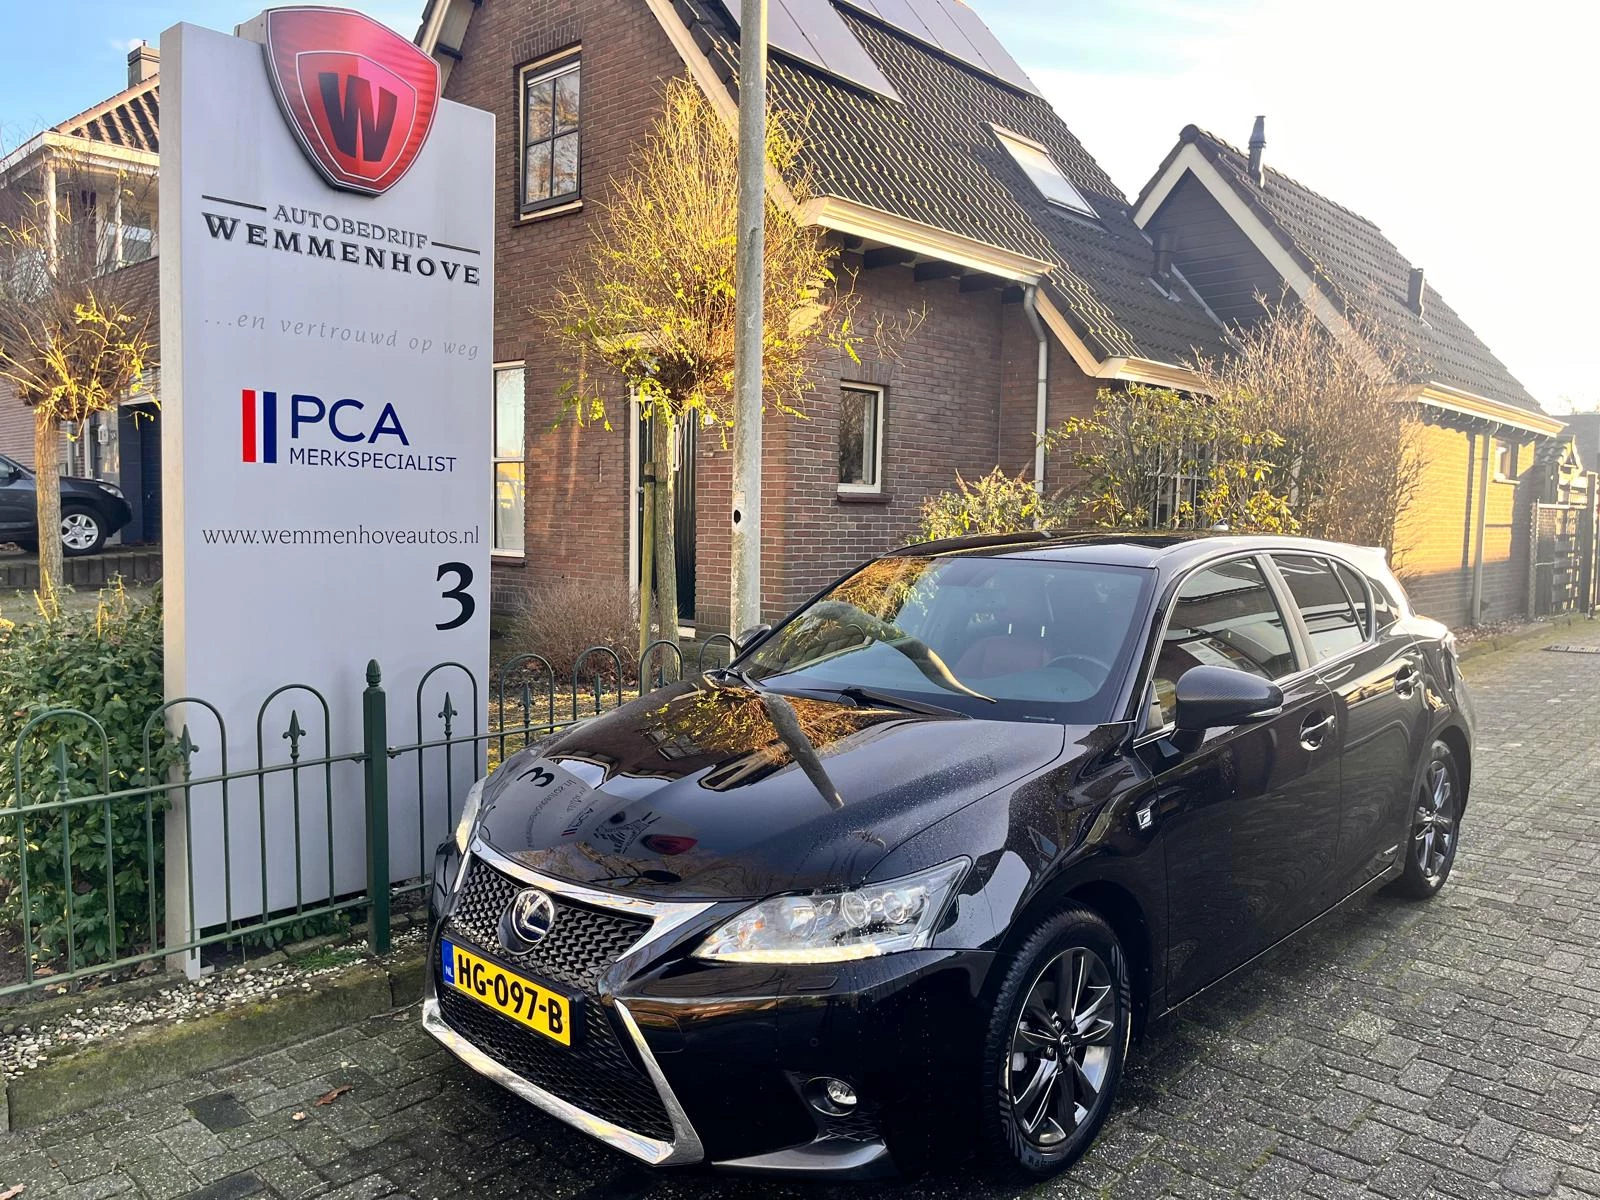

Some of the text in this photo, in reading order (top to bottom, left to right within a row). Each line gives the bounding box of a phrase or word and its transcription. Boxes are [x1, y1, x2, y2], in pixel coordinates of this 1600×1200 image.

[318, 72, 398, 162] W
[201, 212, 480, 285] WEMMENHOVE
[273, 204, 428, 249] AUTOBEDRIJF
[204, 313, 478, 360] ...en vertrouwd op weg
[291, 394, 409, 446] PCA
[289, 447, 457, 472] MERKSPECIALIST
[202, 525, 479, 545] www.wemmenhoveautos.nl
[435, 561, 476, 631] 3
[445, 965, 454, 977] NL
[457, 954, 564, 1034] HG-097-B
